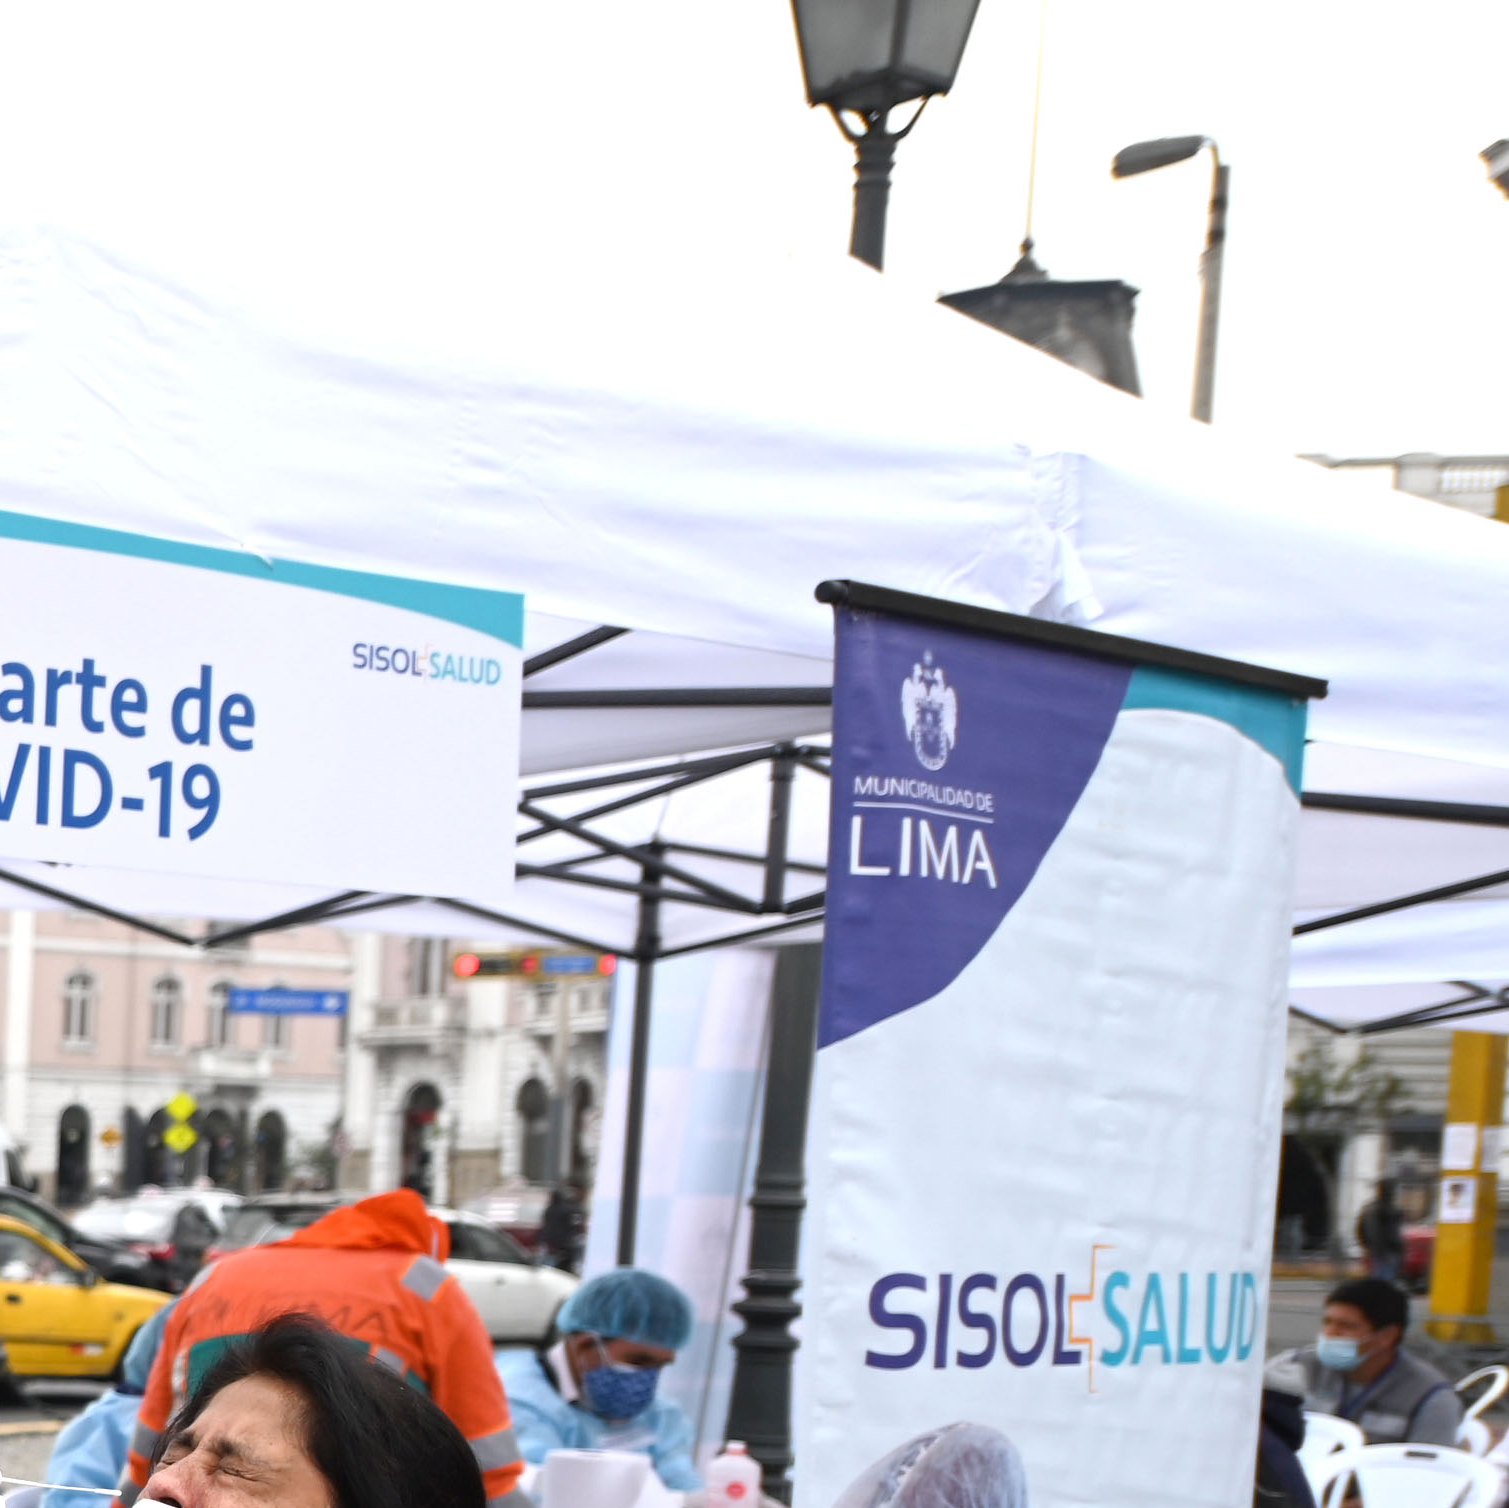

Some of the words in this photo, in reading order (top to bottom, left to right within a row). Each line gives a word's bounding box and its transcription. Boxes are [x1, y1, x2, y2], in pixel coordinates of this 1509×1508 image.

[352, 642, 422, 676] SISOL
[429, 651, 501, 685] SALUD
[171, 664, 256, 751] de
[854, 775, 974, 809] MUNICIPALIDAD
[976, 791, 994, 812] DE
[849, 814, 997, 889] LIMA
[864, 1272, 1082, 1370] SISOL
[1099, 1270, 1258, 1367] SALUD
